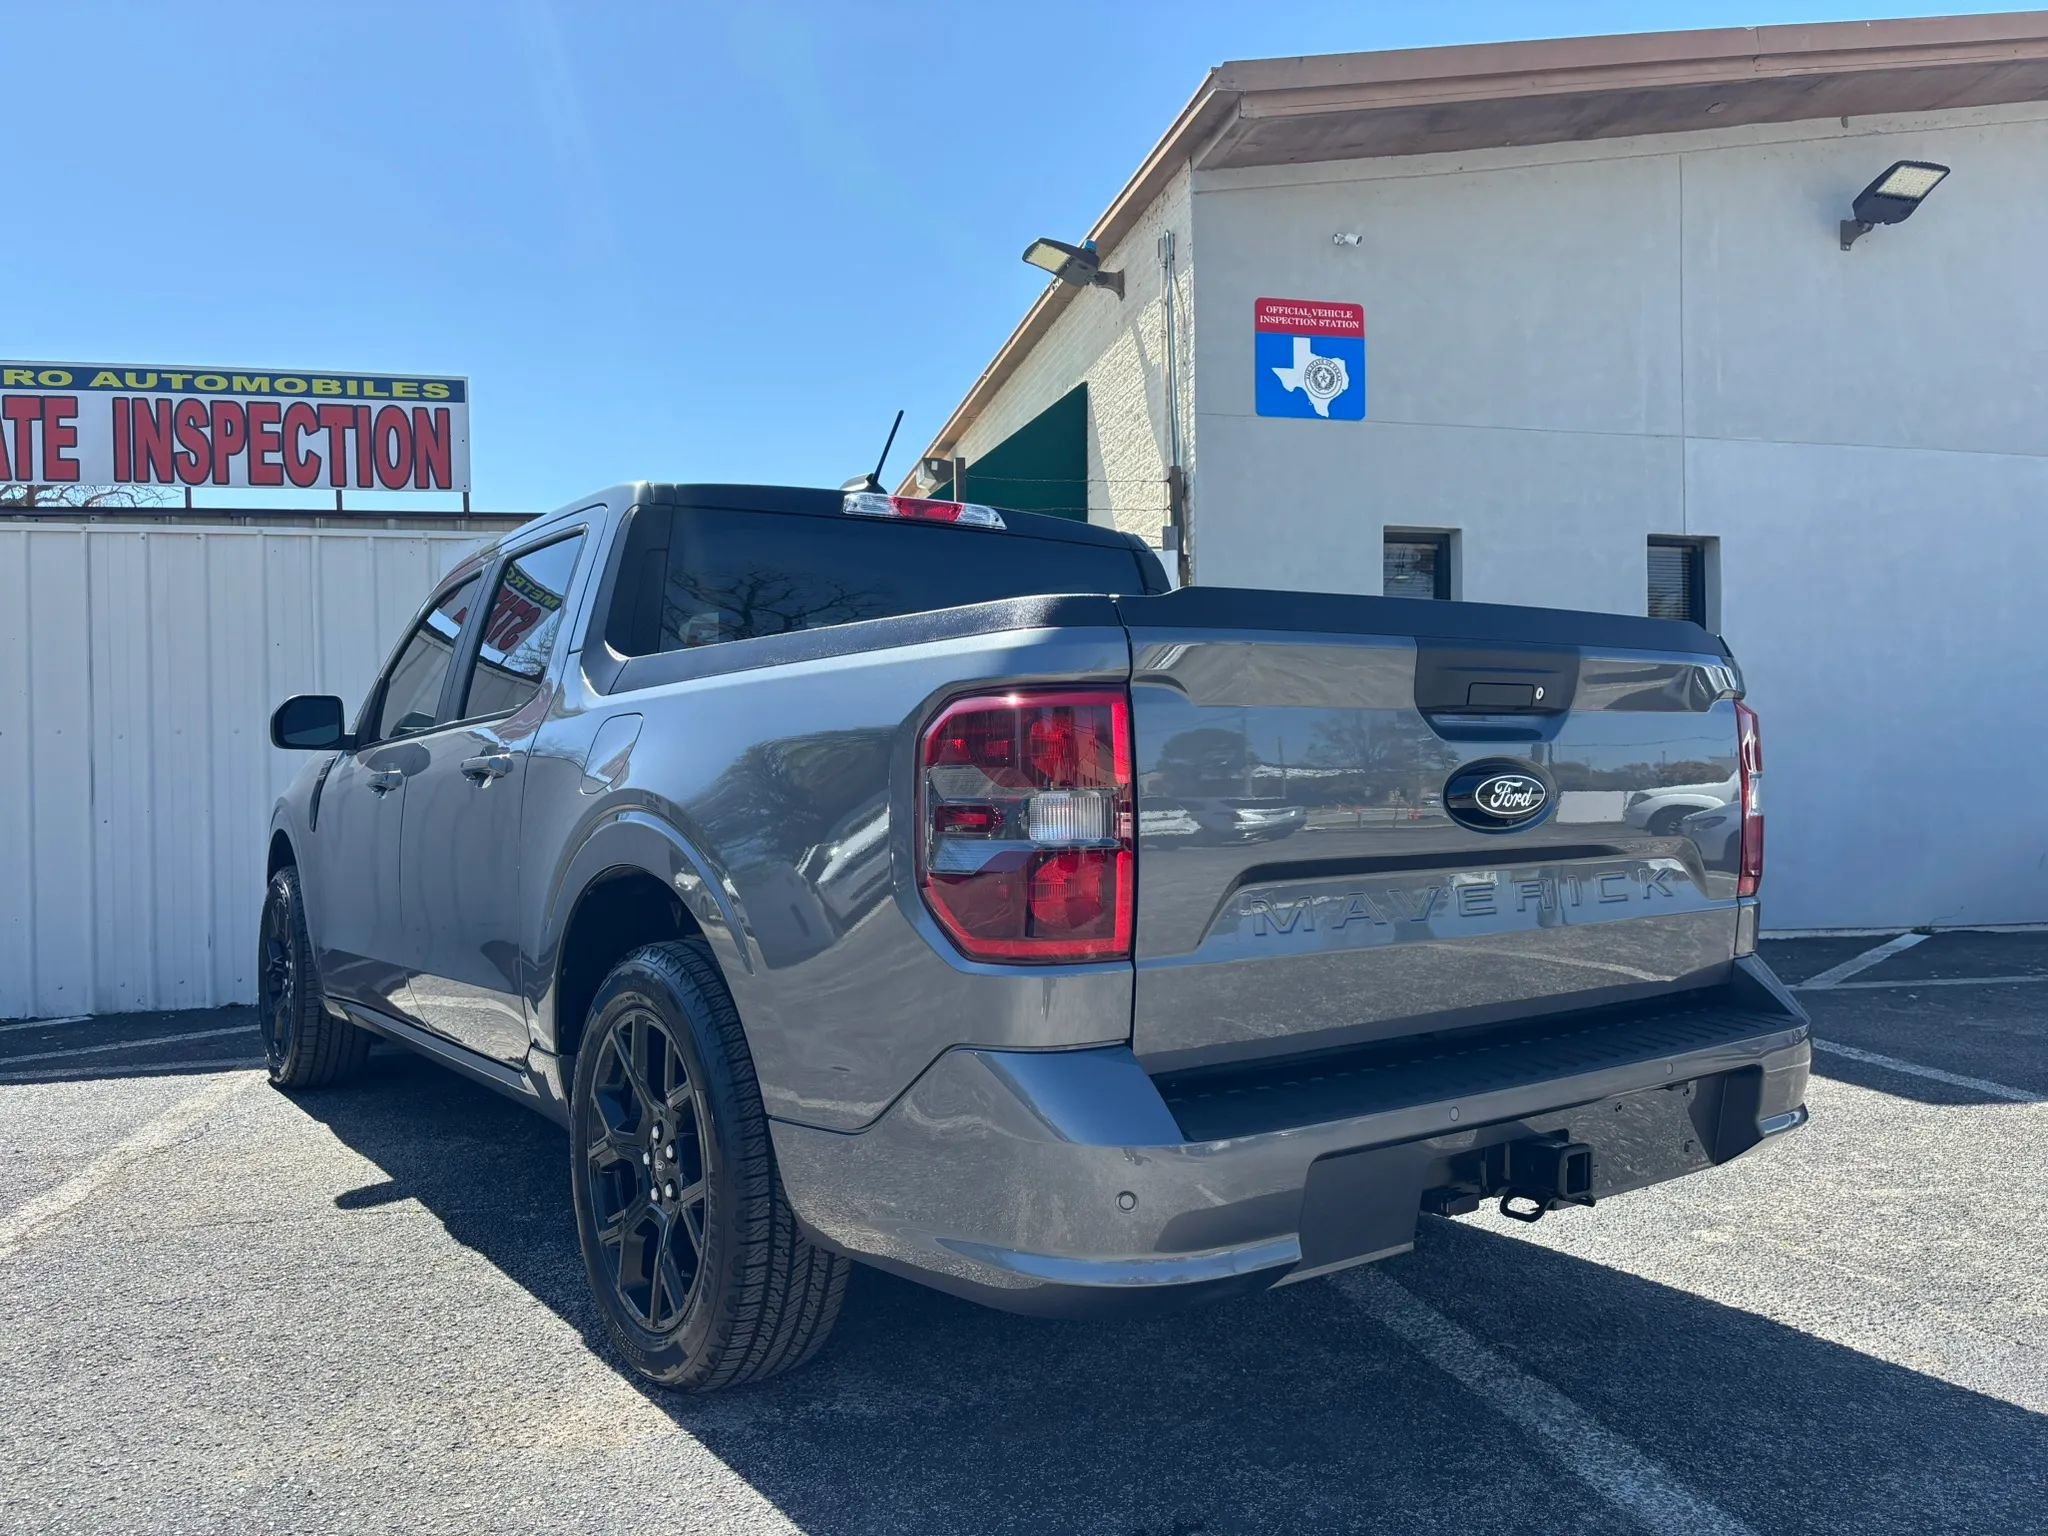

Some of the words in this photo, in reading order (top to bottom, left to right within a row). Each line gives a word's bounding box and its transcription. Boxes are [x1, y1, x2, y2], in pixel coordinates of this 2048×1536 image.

[1260, 315, 1317, 326] INSPECTION
[1319, 319, 1360, 328] STATION
[1266, 305, 1309, 315] OFFICIAL
[1312, 308, 1353, 318] VEHICLE
[88, 370, 451, 399] AUTOMOBILES
[0, 394, 80, 482] TE
[112, 396, 453, 491] INSPECTION
[1490, 780, 1533, 808] Ford
[1250, 867, 1674, 937] MAVERICK
